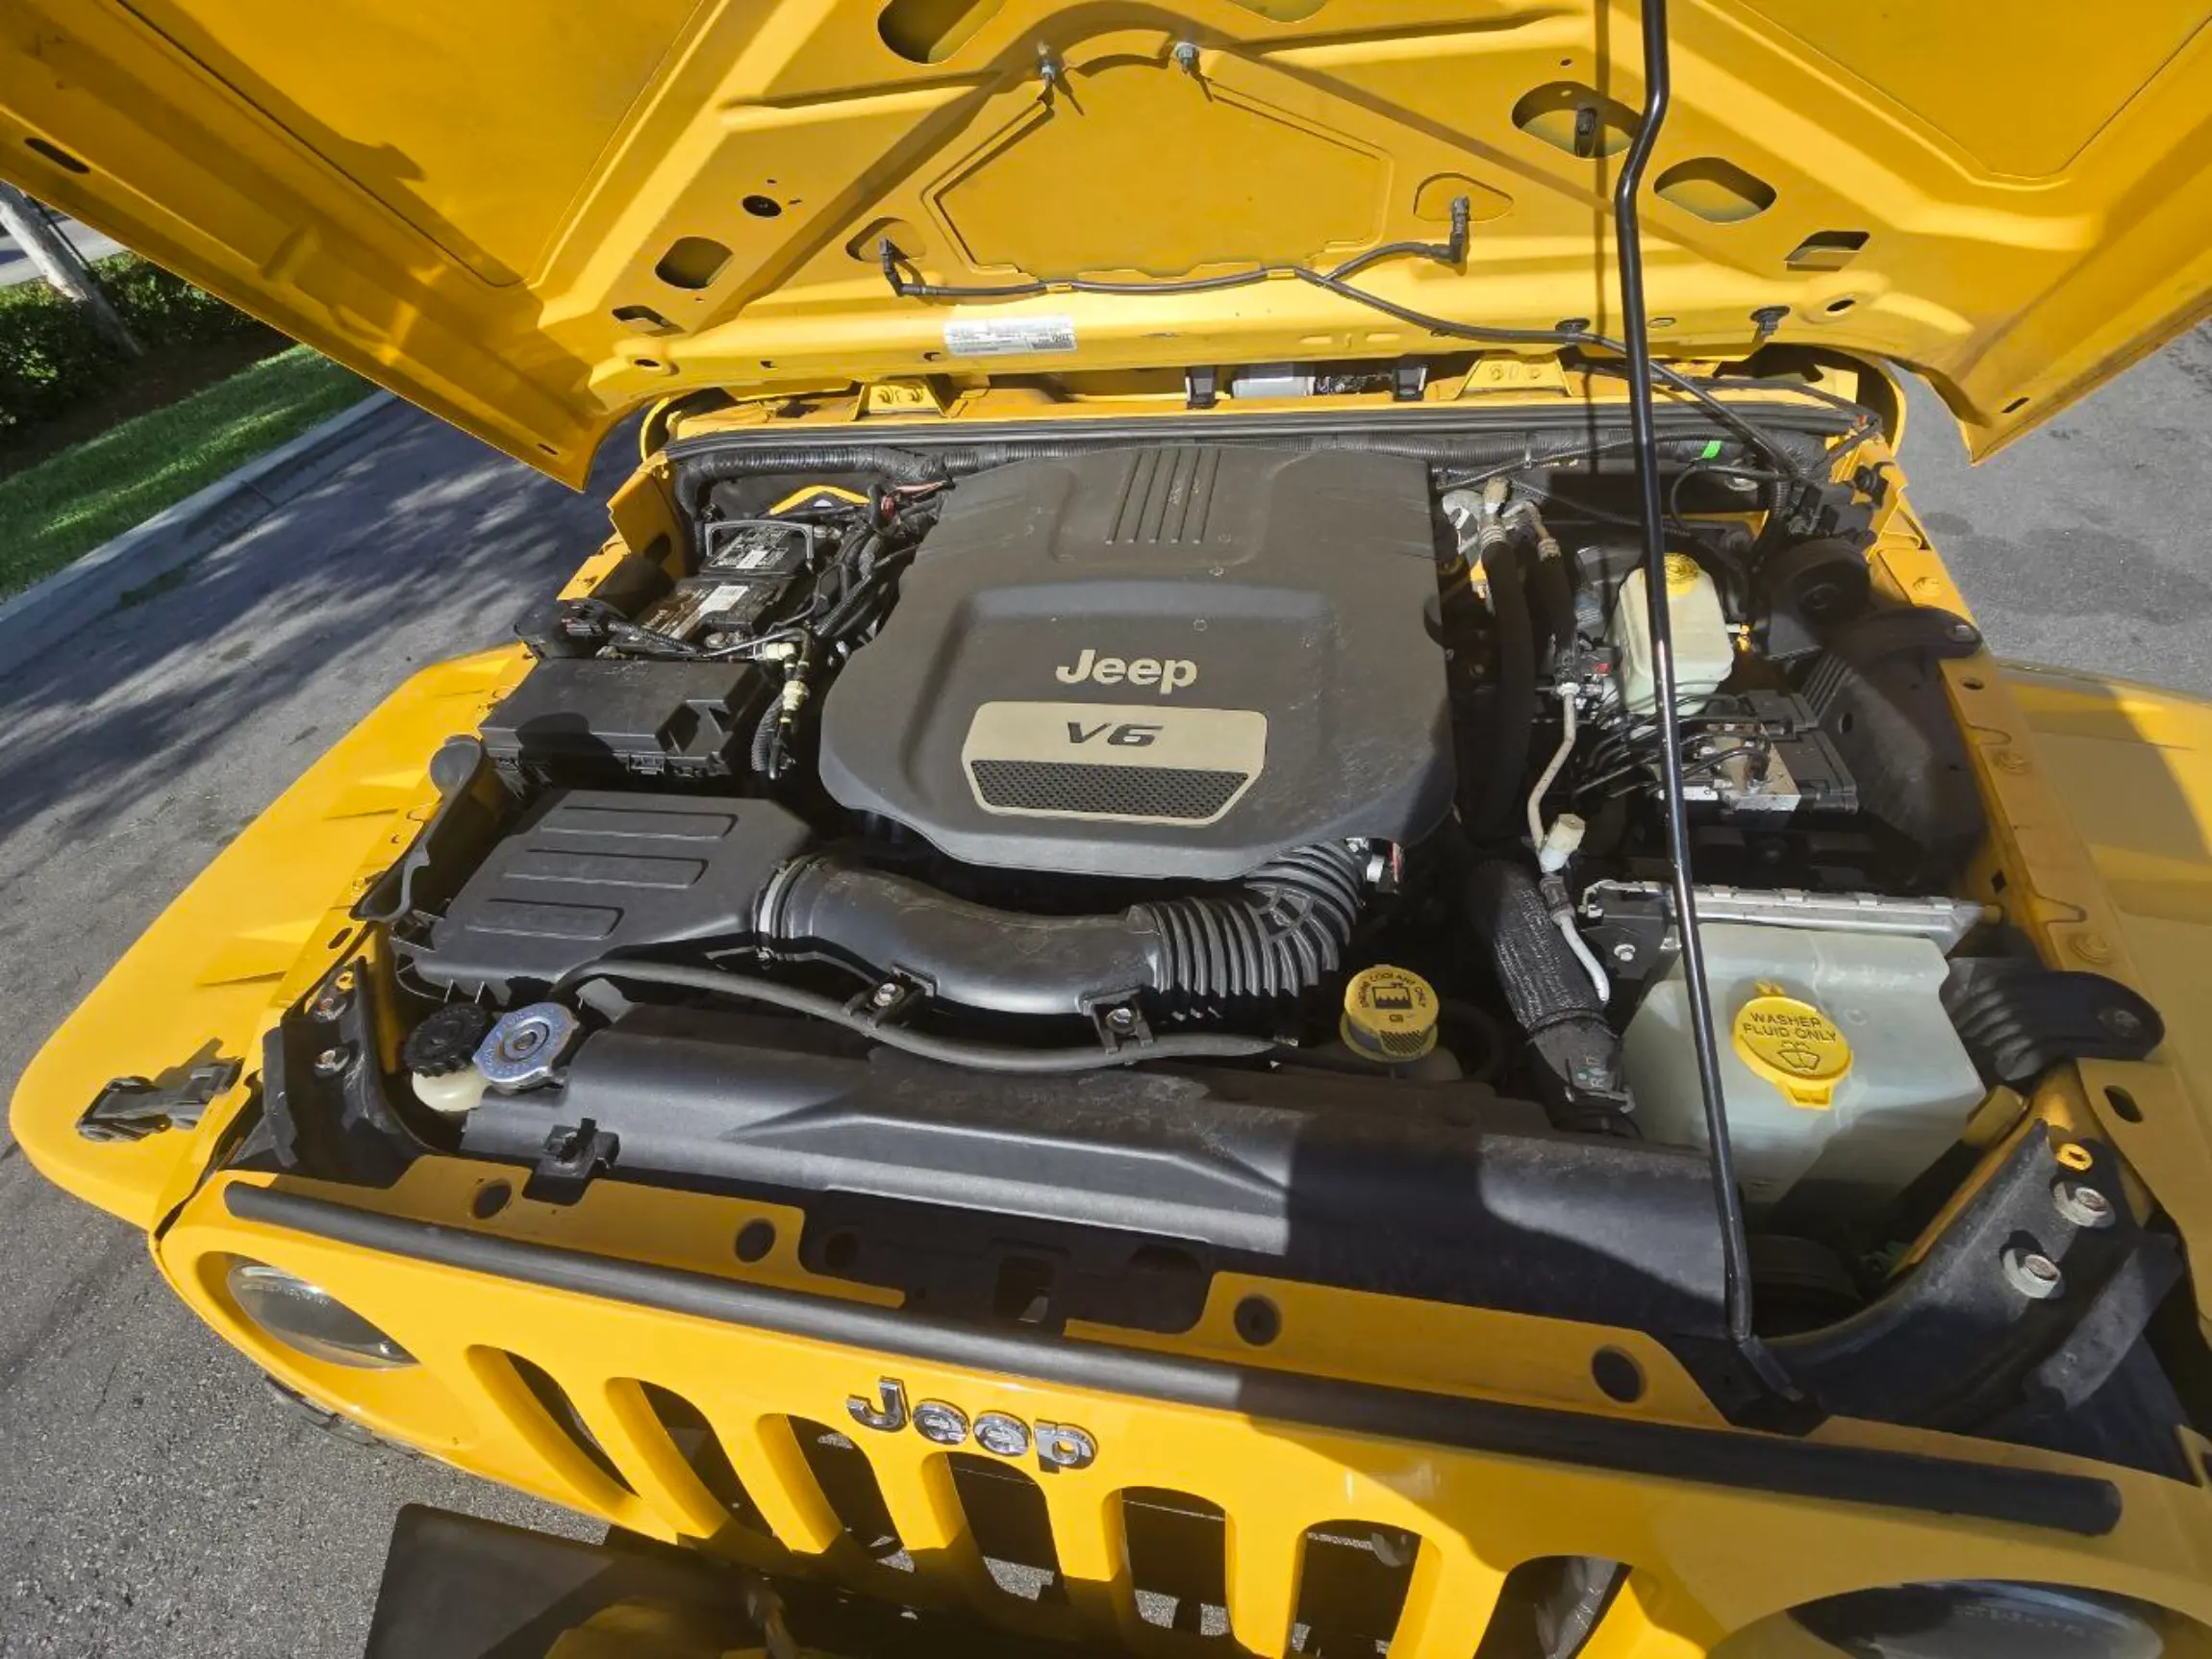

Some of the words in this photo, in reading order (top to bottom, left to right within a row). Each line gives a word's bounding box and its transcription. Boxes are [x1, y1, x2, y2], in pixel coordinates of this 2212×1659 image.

[1055, 649, 1198, 694] Jeep
[1067, 721, 1164, 746] V6
[1742, 1022, 1790, 1038] FLUID
[1794, 1027, 1836, 1042] ONLY
[1750, 1012, 1822, 1027] WASHER
[846, 1376, 1098, 1474] Jeep
